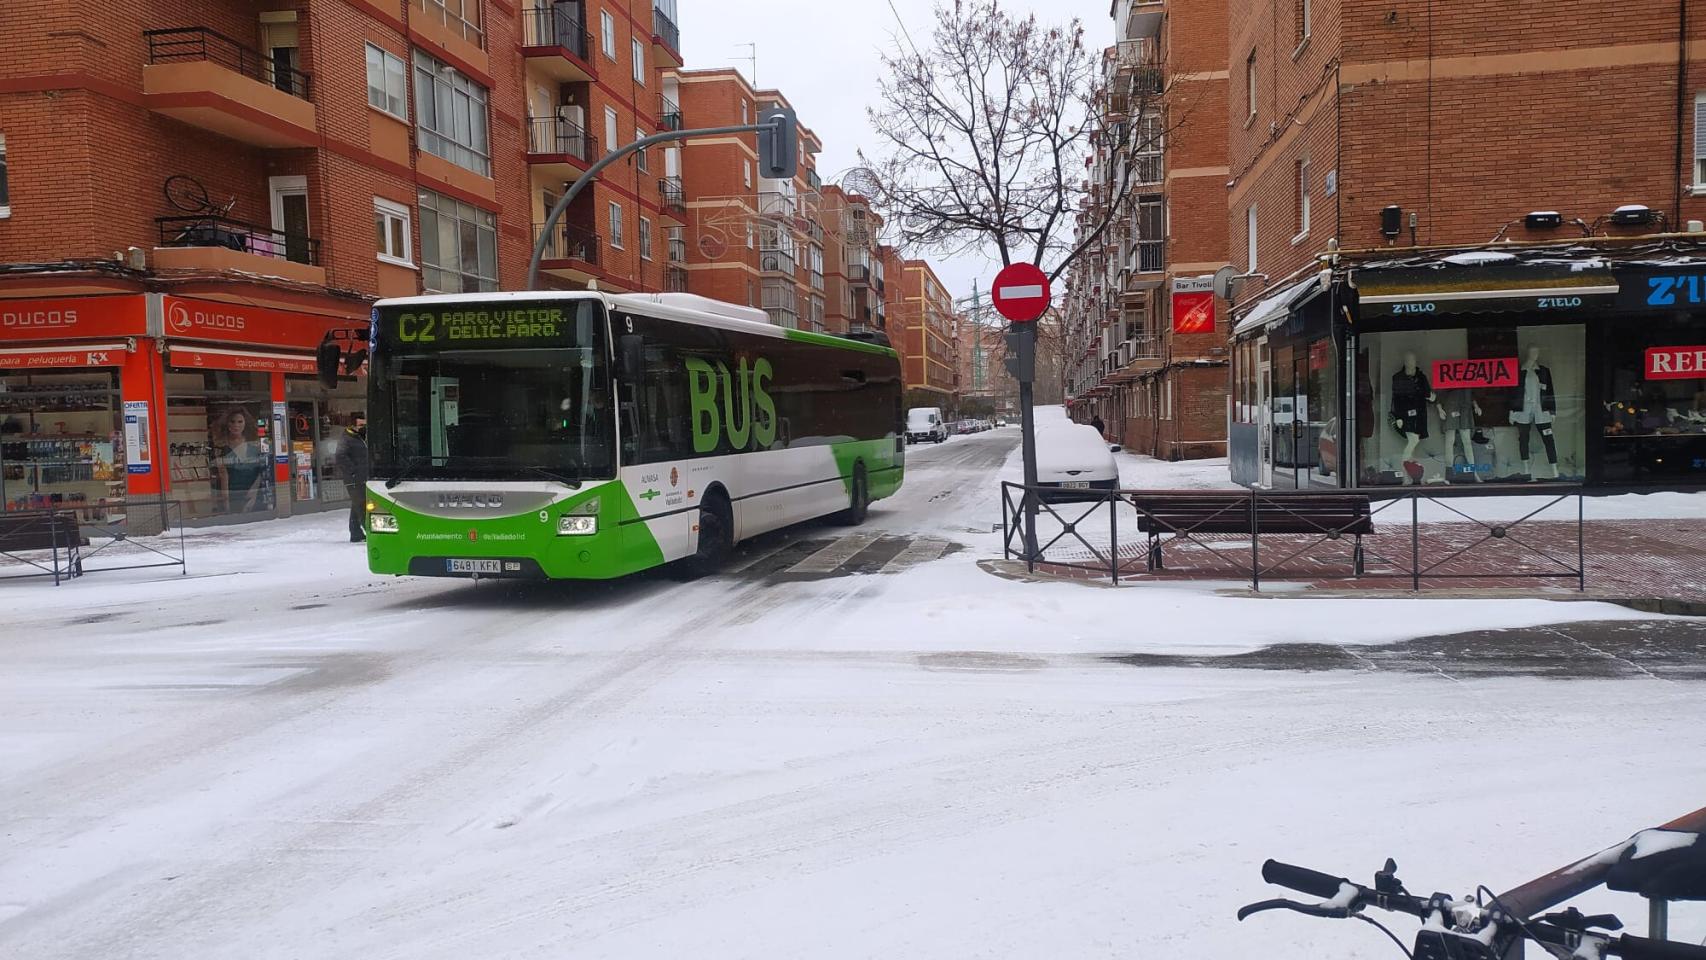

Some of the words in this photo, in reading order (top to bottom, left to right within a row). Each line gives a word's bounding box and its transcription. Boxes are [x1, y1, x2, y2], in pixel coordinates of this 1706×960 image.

[1647, 275, 1706, 305] Z'I
[1393, 302, 1436, 313] Z'IELO
[1538, 297, 1582, 308] Z'IELO
[3, 310, 77, 326] DUCOS
[195, 311, 245, 329] DUCOS
[626, 316, 633, 333] 9
[400, 313, 435, 342] C2
[1439, 360, 1510, 384] REBAJA
[685, 356, 776, 452] BUS
[539, 510, 549, 523] 9
[453, 562, 476, 571] 6481
[480, 562, 499, 571] KFK
